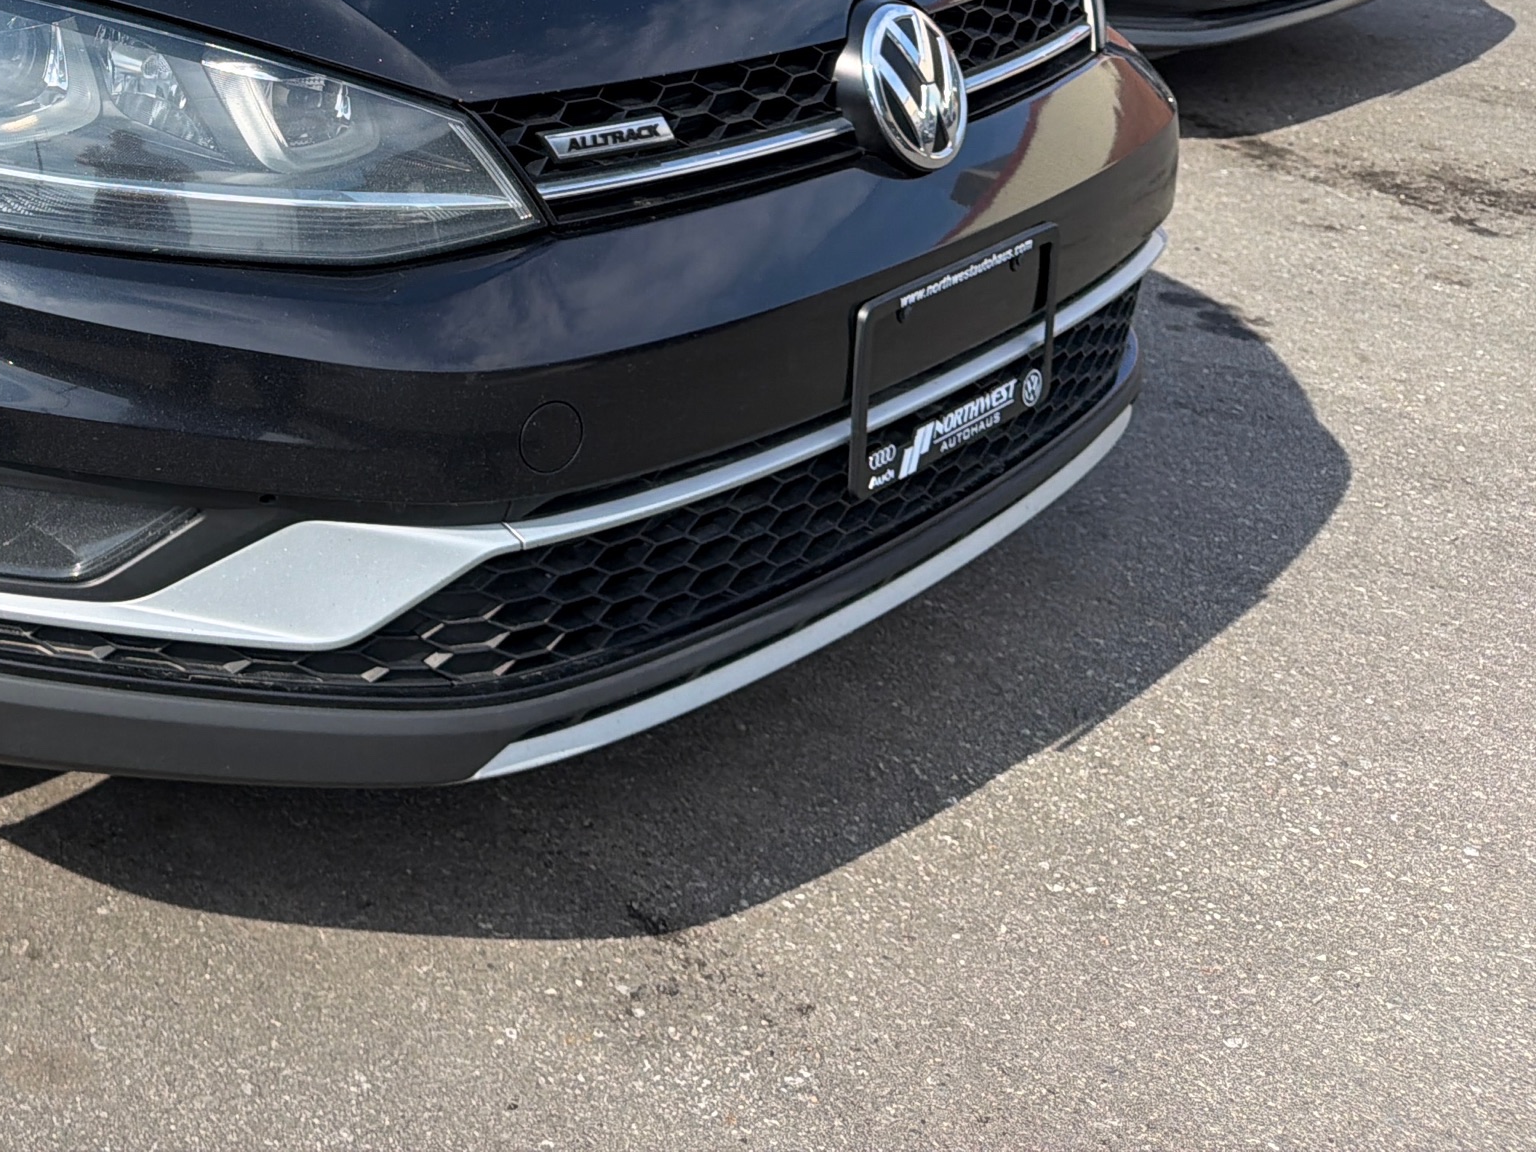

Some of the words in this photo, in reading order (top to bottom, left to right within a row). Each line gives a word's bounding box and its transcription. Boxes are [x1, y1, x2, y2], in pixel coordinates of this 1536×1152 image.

[567, 123, 661, 153] ALLTRACK
[899, 238, 1034, 309] www.northwestautohaus.com
[932, 378, 1018, 440] NORTHWEST
[939, 410, 1002, 454] AUTOHAUS
[868, 467, 896, 490] Audi
